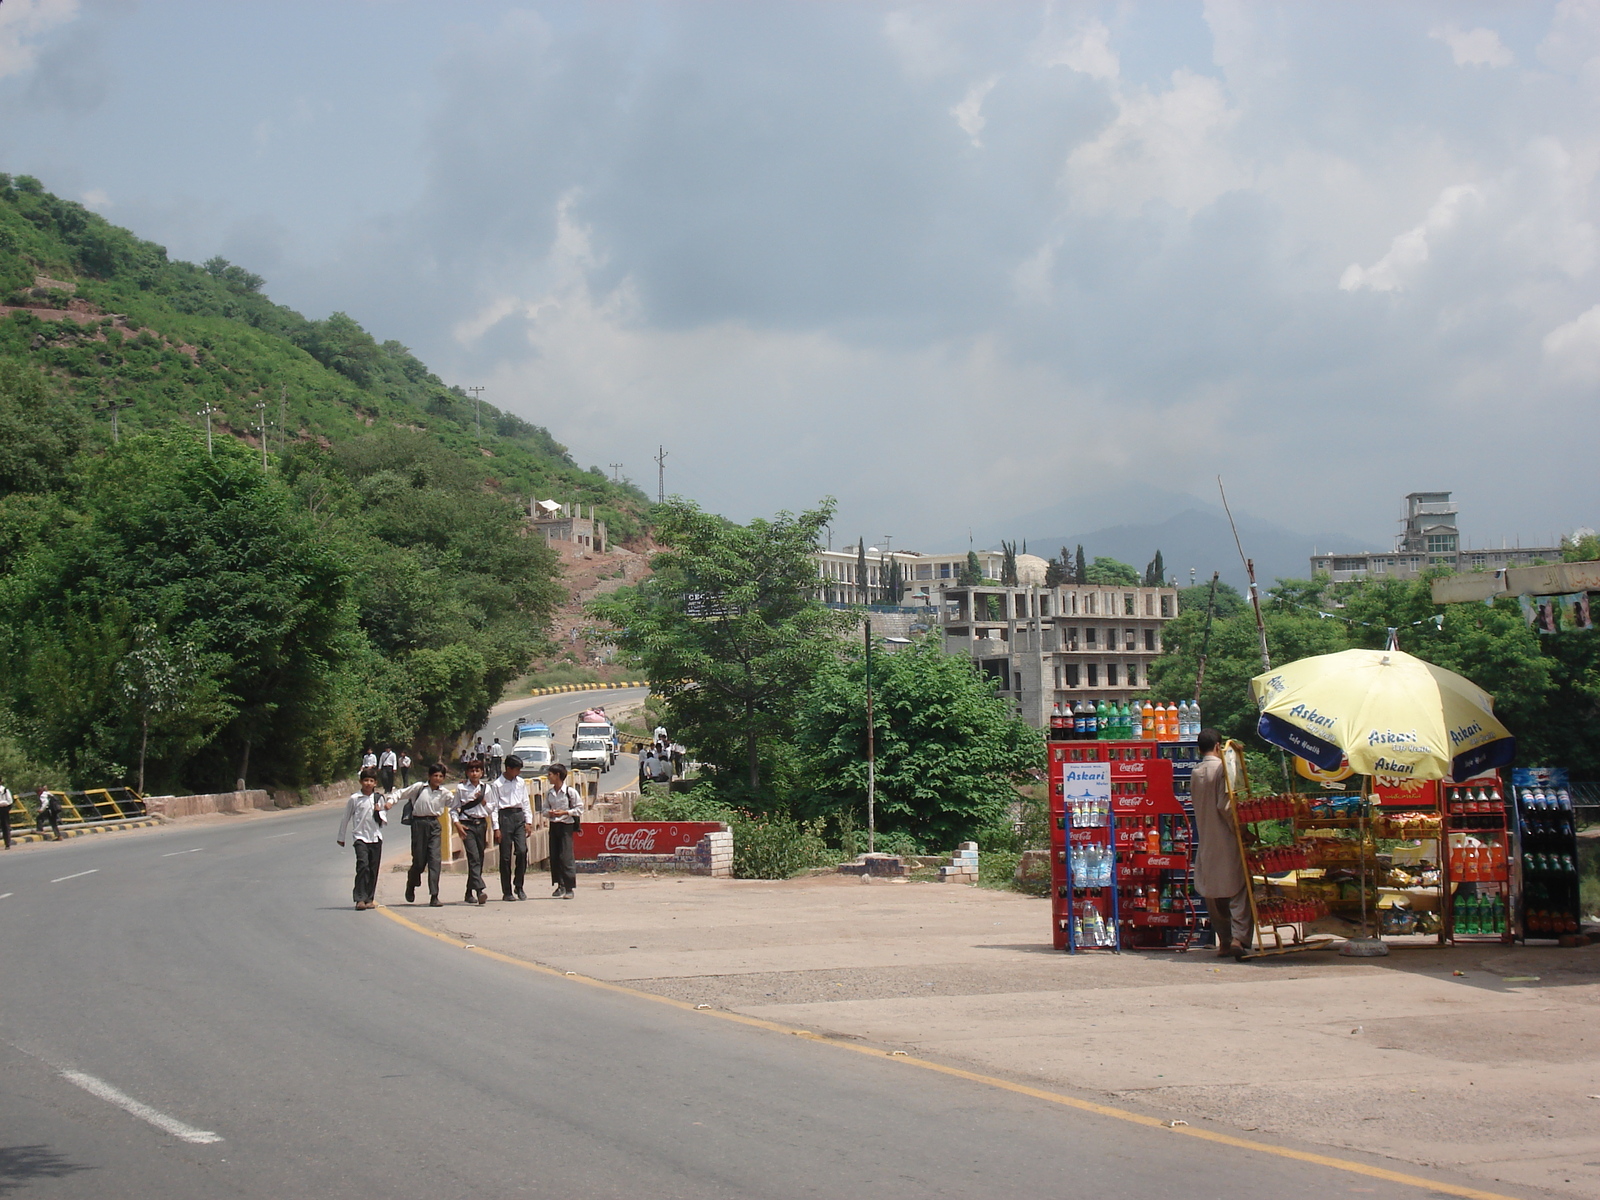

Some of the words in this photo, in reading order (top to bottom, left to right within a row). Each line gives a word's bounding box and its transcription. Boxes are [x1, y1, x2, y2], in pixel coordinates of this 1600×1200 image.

[1289, 704, 1338, 728] Askari
[1368, 729, 1417, 746] Askari
[1450, 719, 1483, 747] Askari
[1289, 733, 1301, 745] Safe
[1301, 740, 1320, 755] Health
[1118, 763, 1144, 772] Coca-Cola
[1375, 757, 1416, 774] Askari
[1067, 771, 1105, 782] Askari
[605, 828, 659, 851] Coca-Cola
[1148, 857, 1171, 866] Coca-Cola
[1147, 914, 1169, 923] Coca-Cola
